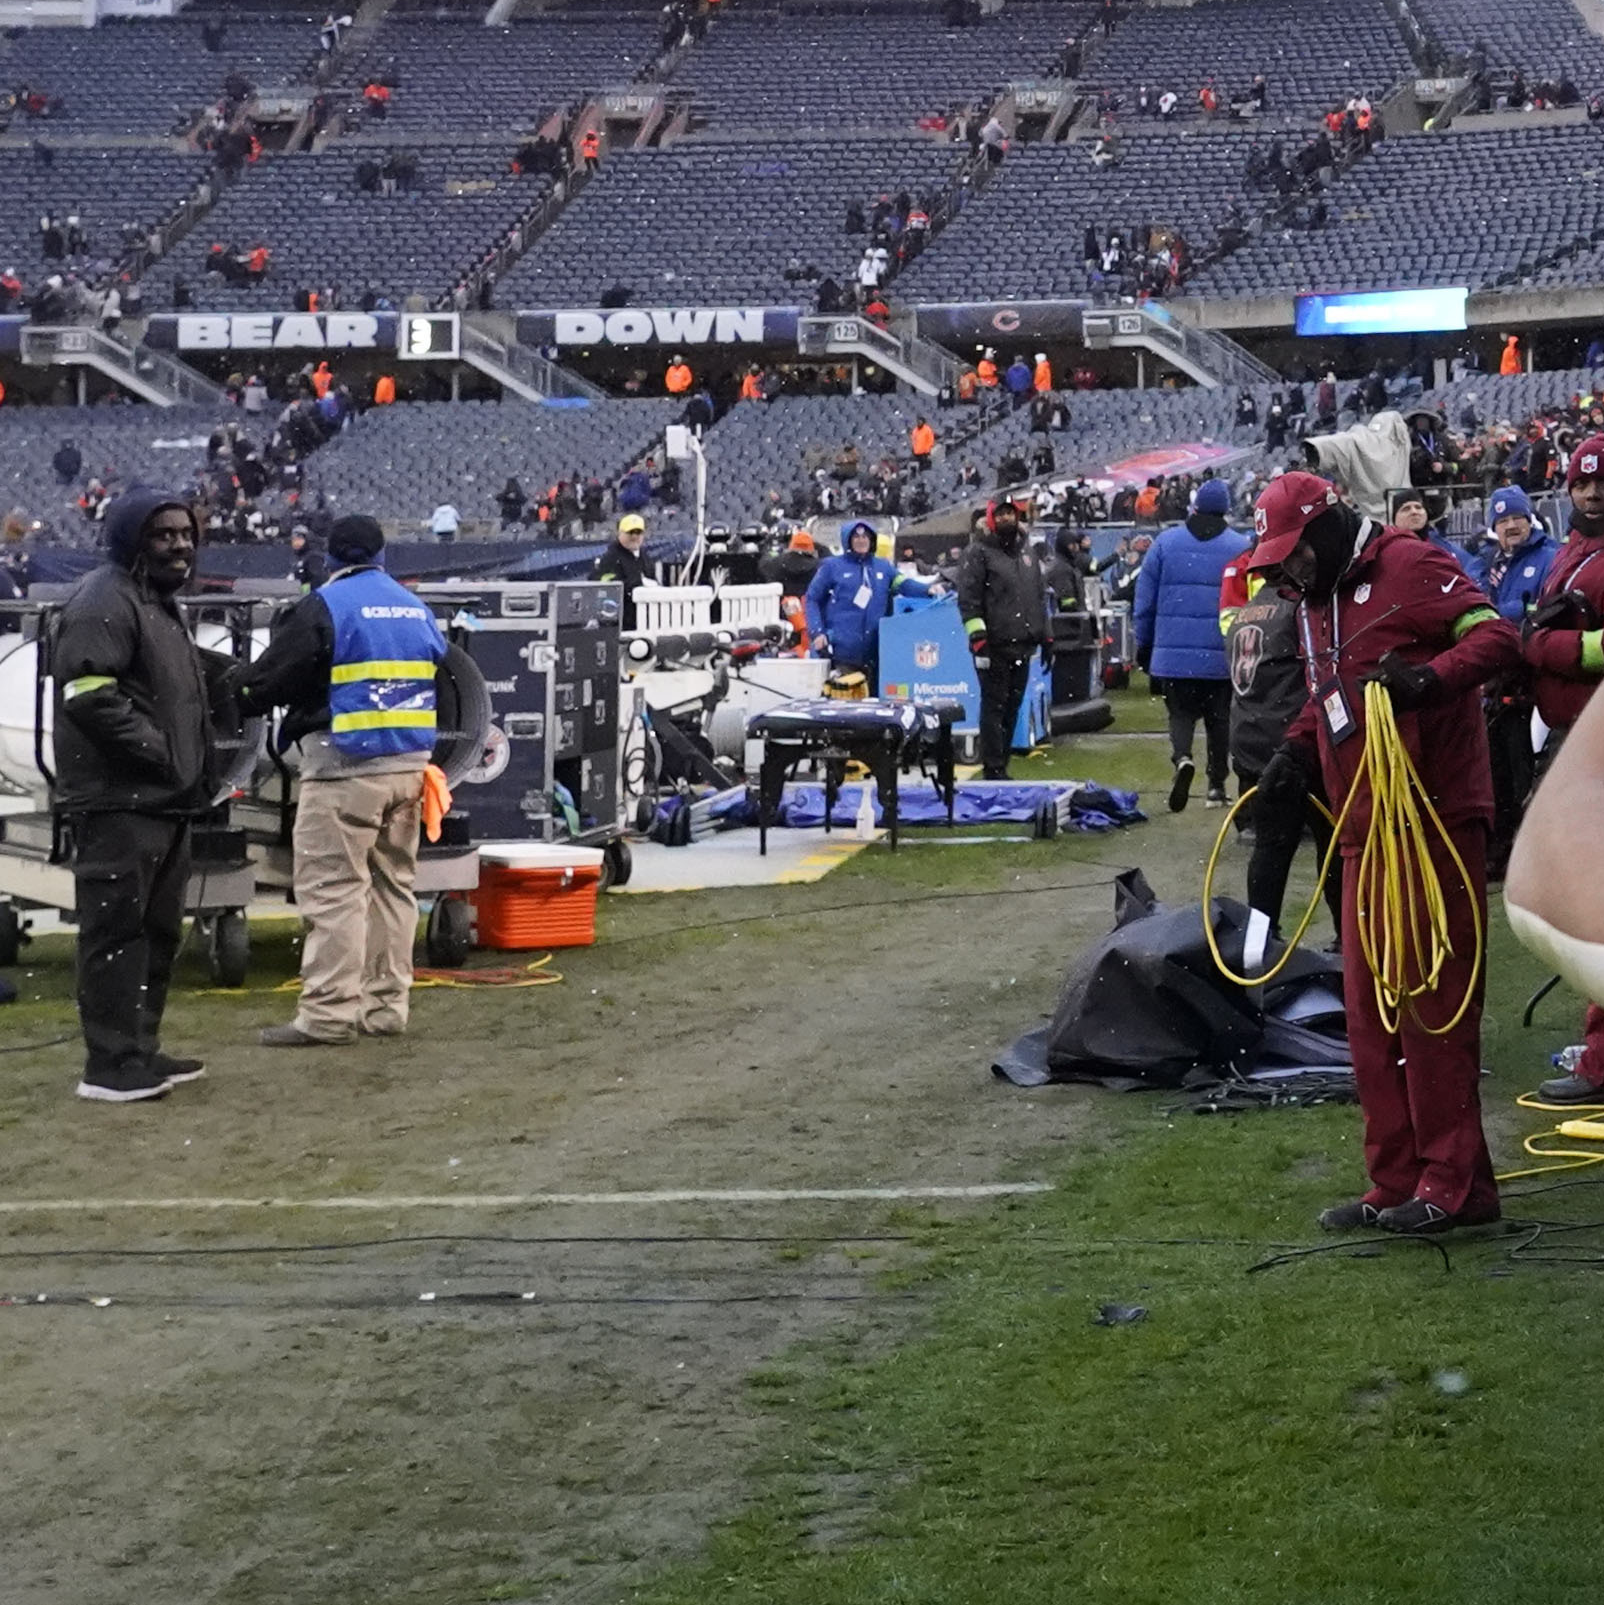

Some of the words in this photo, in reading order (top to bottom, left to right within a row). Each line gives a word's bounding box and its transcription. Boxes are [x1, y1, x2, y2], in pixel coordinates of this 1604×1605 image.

[178, 315, 378, 348] BEAR
[556, 311, 764, 344] DOWN
[913, 681, 968, 694] Microsoft
